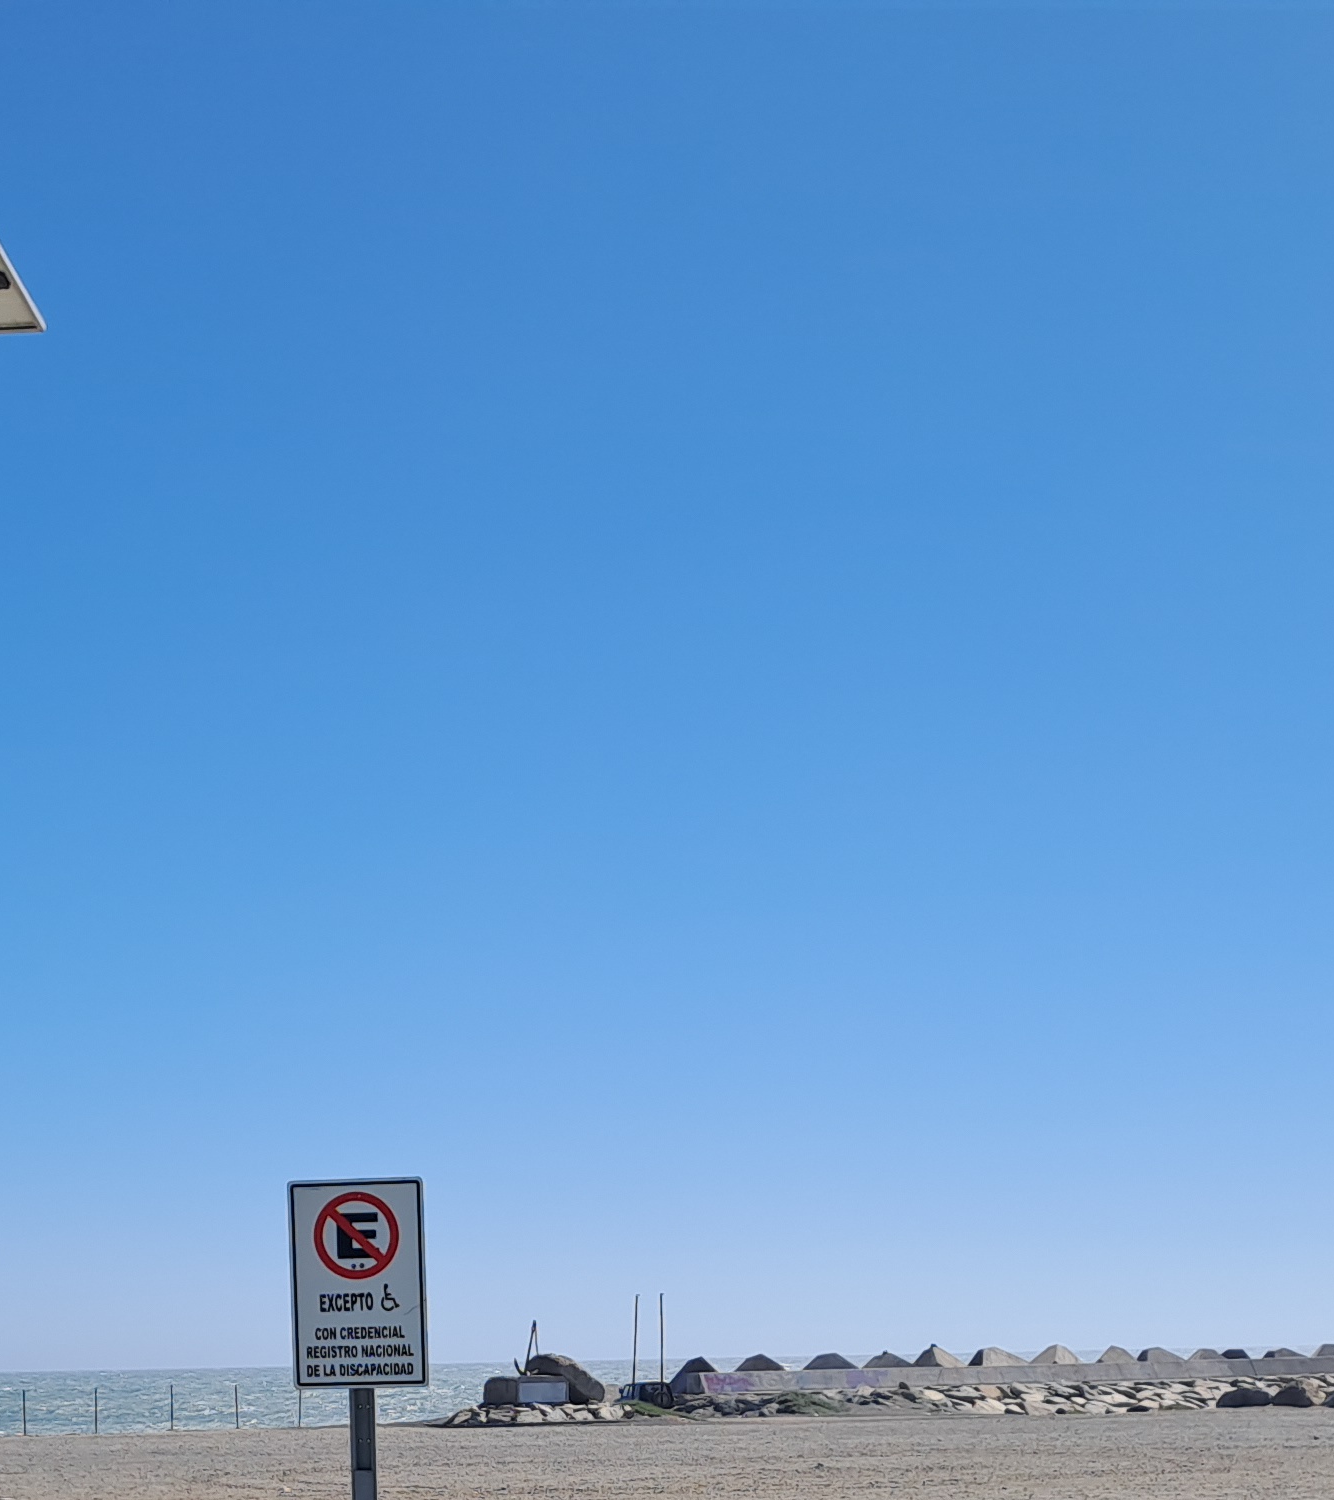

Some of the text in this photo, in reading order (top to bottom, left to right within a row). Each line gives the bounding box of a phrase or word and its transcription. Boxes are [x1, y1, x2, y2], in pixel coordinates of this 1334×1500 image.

[336, 1212, 380, 1259] E
[319, 1292, 374, 1313] EXCEPTO
[315, 1325, 405, 1341] CON CREDENCIAL
[306, 1343, 414, 1360] REGISTRO NACIONAL
[306, 1362, 414, 1378] DE LA DISCAPACIDAD
